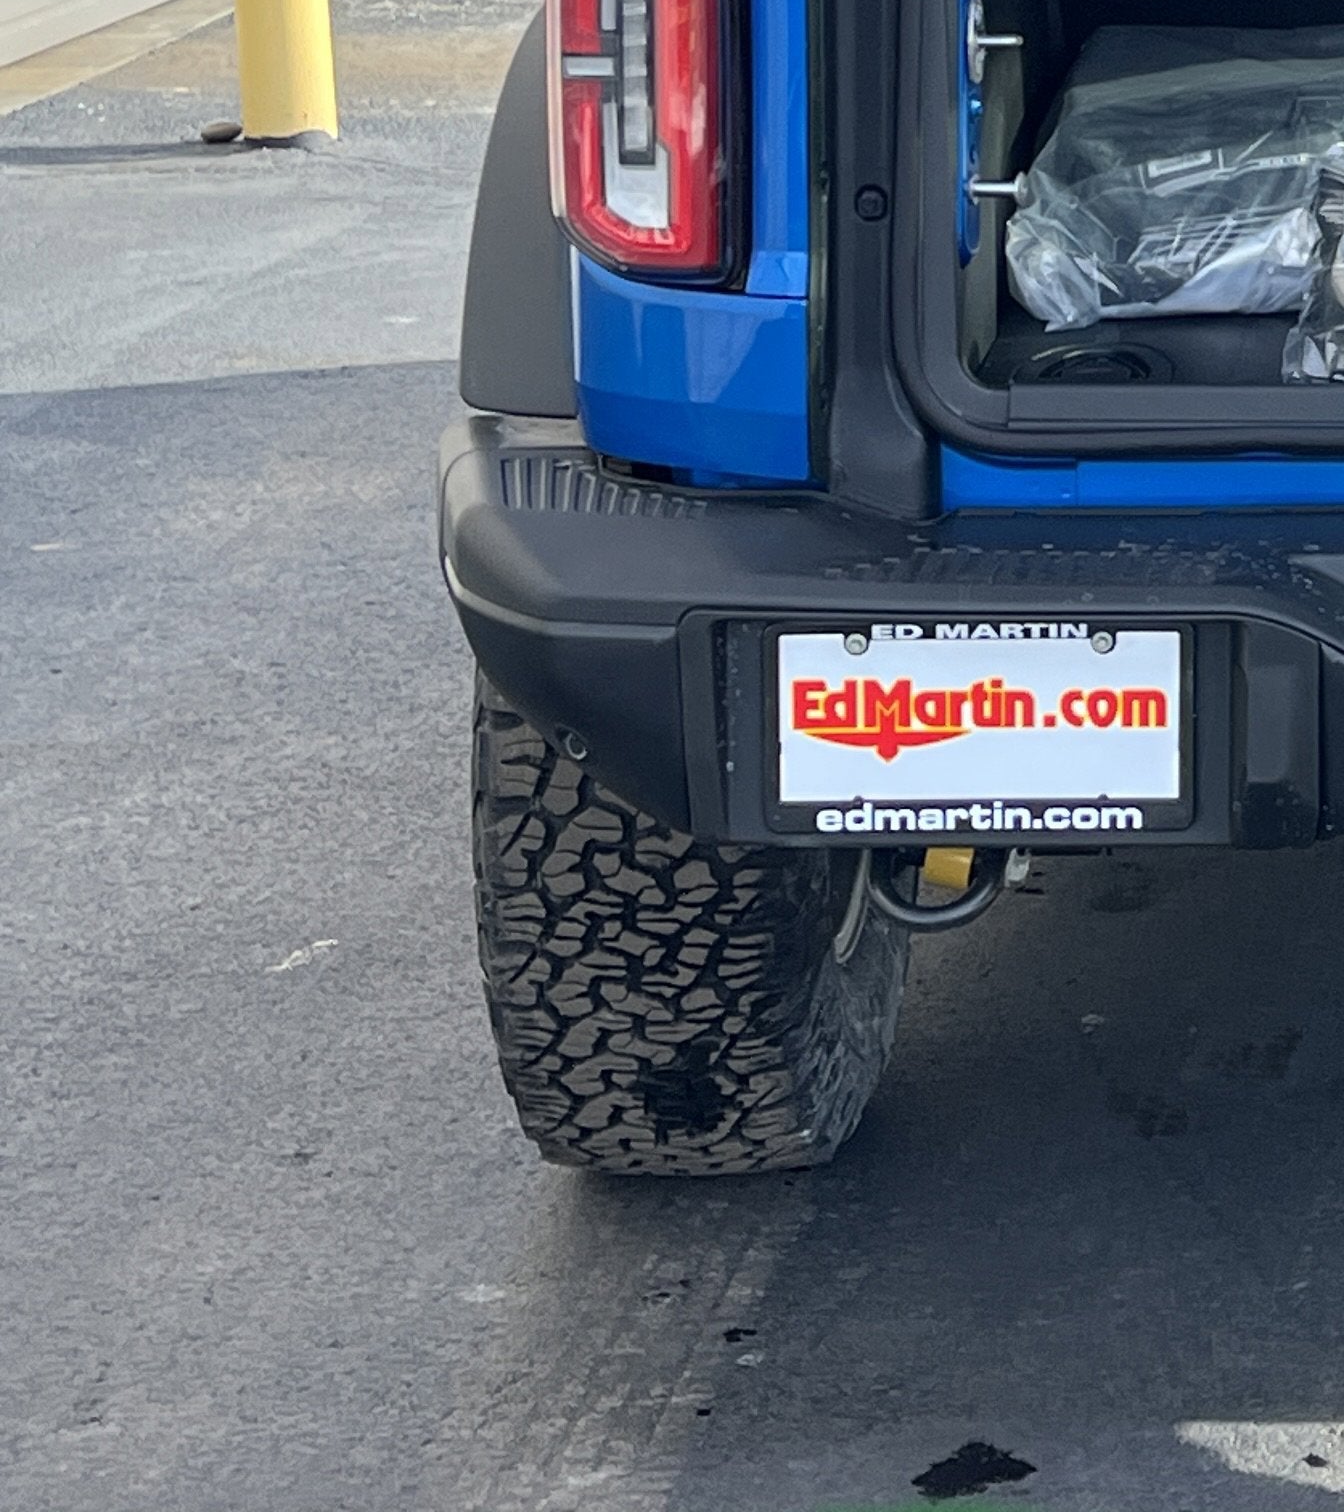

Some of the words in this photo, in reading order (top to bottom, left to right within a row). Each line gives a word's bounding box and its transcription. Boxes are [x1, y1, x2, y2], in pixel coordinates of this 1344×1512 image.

[871, 624, 922, 640] ED
[935, 623, 1088, 639] MARTIN
[792, 678, 1168, 729] EdMartin.com
[816, 802, 1144, 832] edmartin.com
